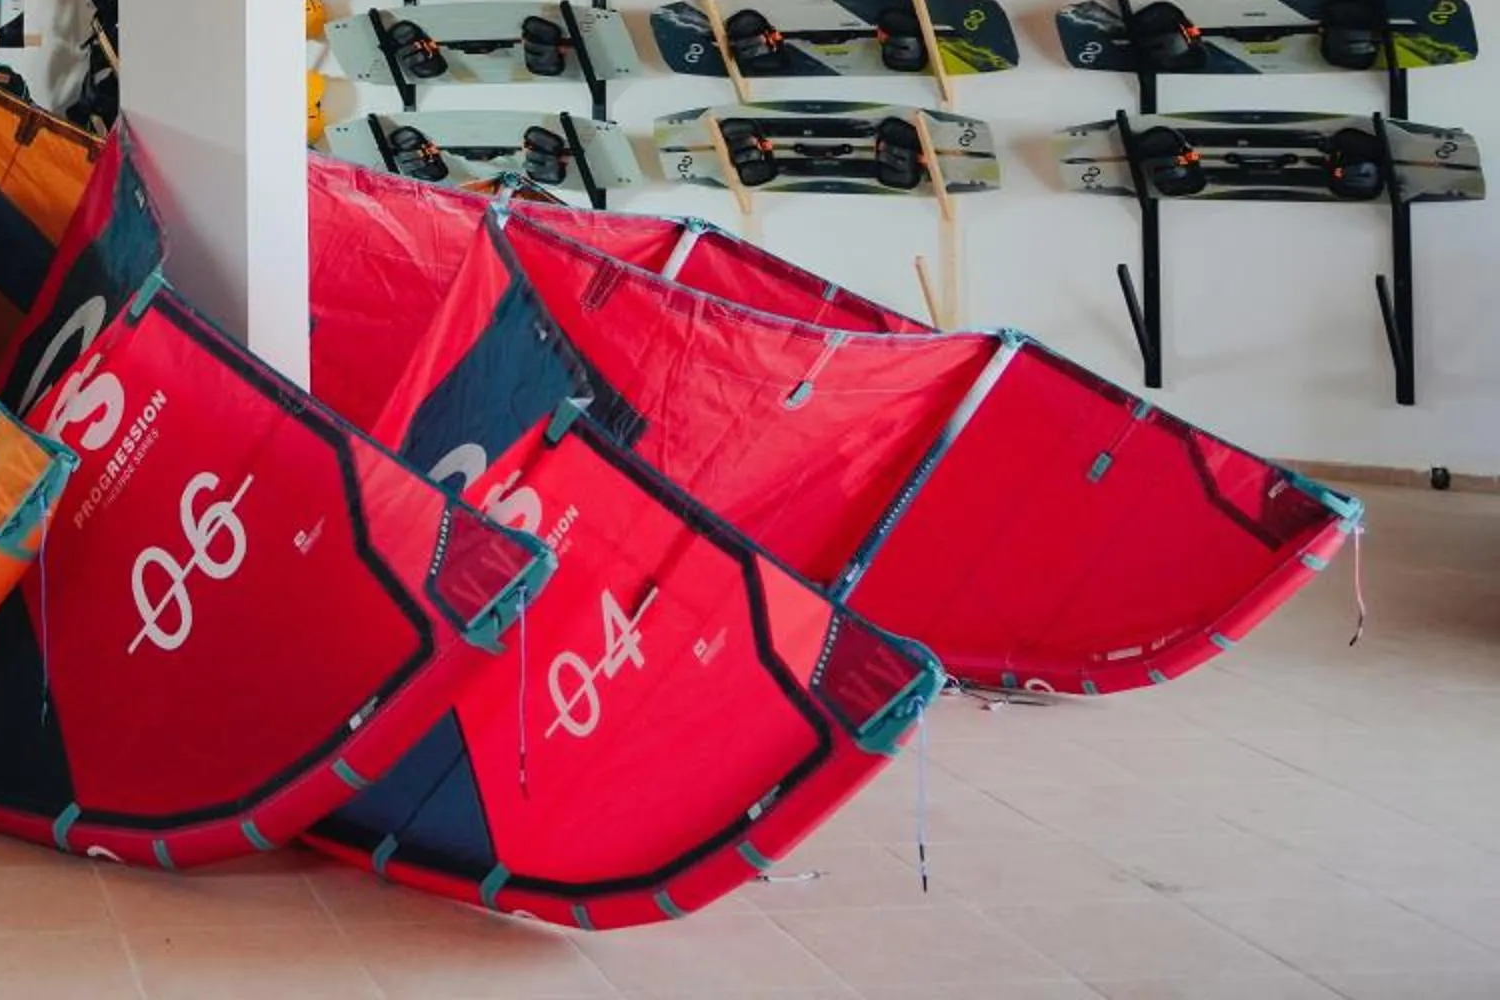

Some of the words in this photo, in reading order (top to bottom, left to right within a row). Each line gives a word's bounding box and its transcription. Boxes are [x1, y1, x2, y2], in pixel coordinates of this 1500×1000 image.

[73, 389, 168, 529] PROGRESSION
[128, 471, 253, 654] 06
[546, 588, 657, 738] 04
